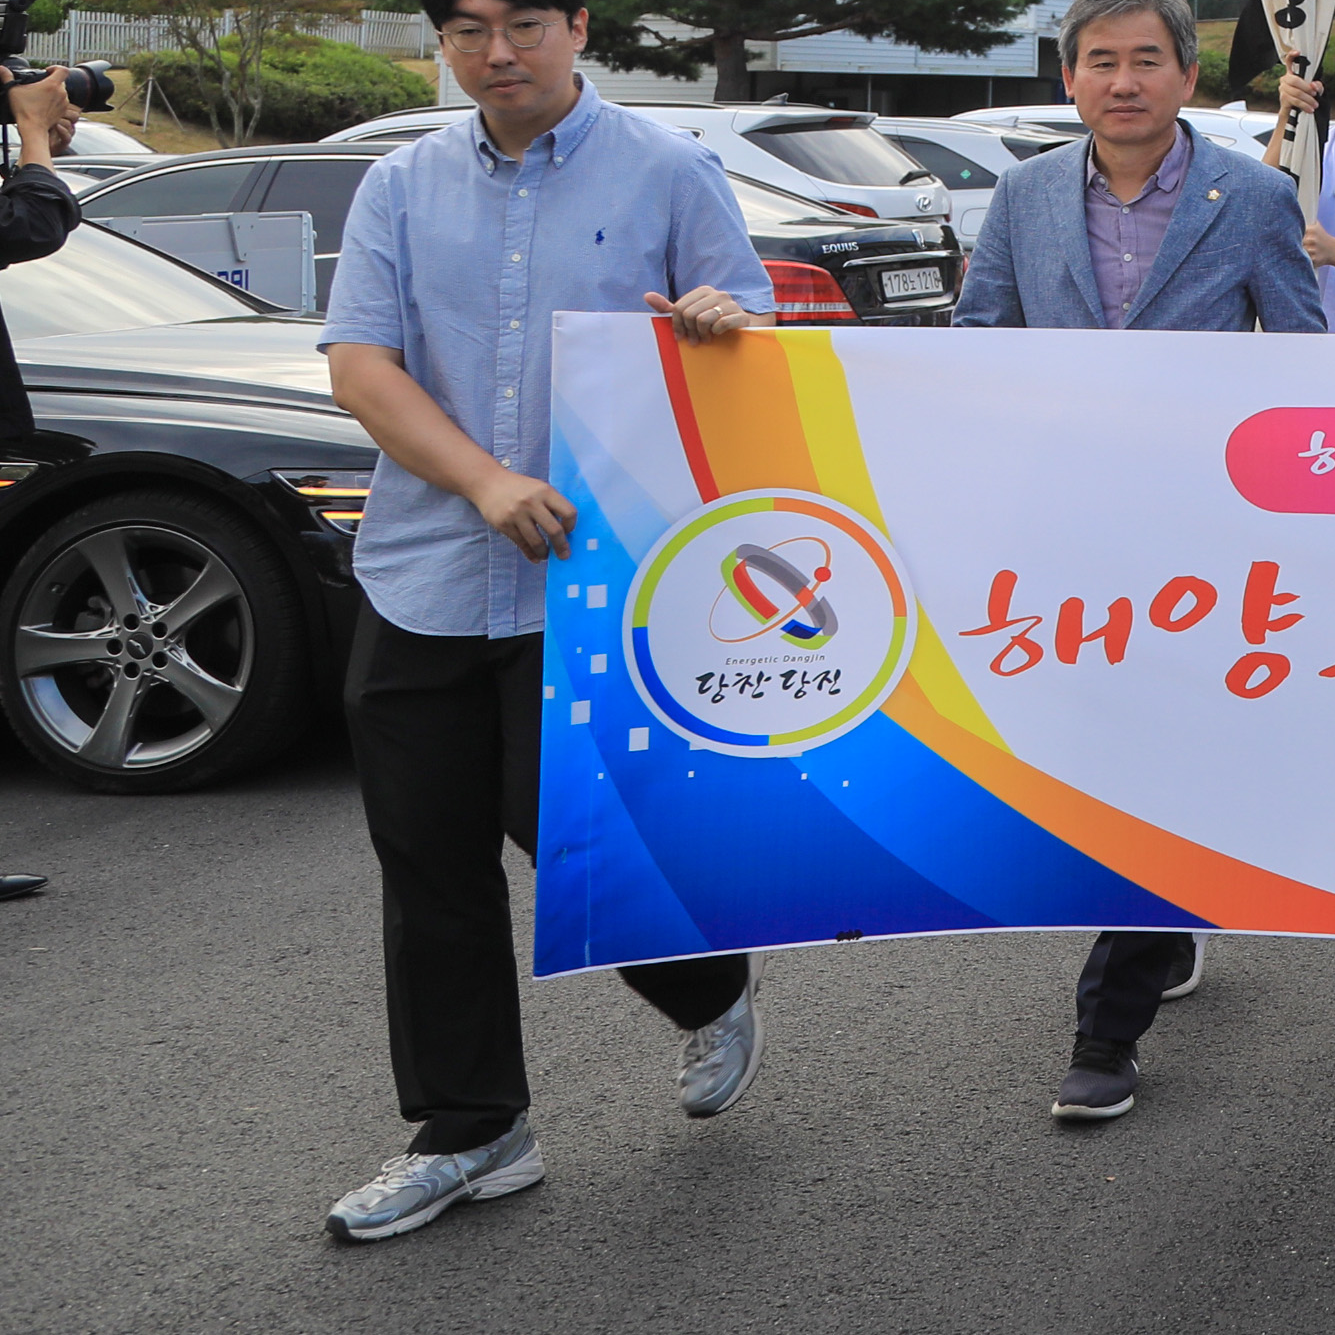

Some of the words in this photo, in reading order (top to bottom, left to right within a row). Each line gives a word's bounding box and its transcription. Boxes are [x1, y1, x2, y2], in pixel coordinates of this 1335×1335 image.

[822, 242, 859, 254] EQUUS
[888, 273, 916, 293] 178노
[725, 655, 778, 667] Energetic
[695, 670, 772, 704] 당찬
[780, 668, 842, 699] 당진
